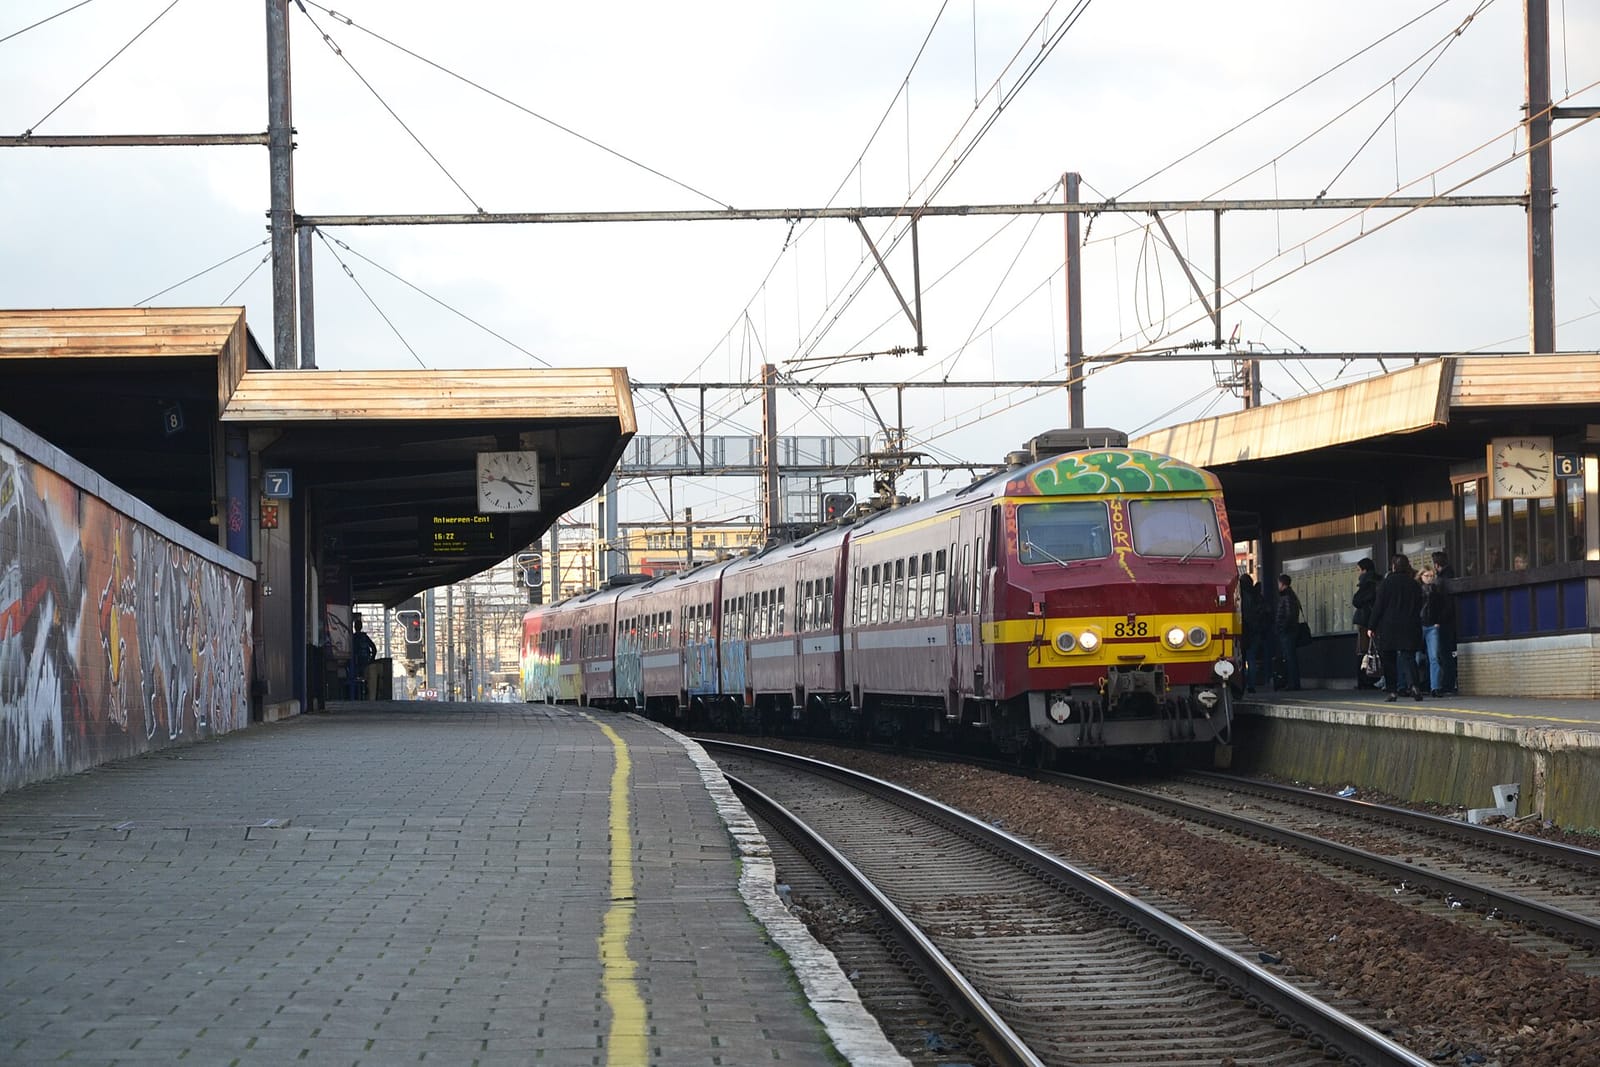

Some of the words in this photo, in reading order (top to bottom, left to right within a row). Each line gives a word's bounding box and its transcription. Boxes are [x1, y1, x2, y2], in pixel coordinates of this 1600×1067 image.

[170, 413, 178, 428] 8
[1561, 458, 1572, 474] 6
[271, 478, 283, 493] 7
[434, 532, 455, 540] 16:22
[1114, 621, 1148, 637] 838
